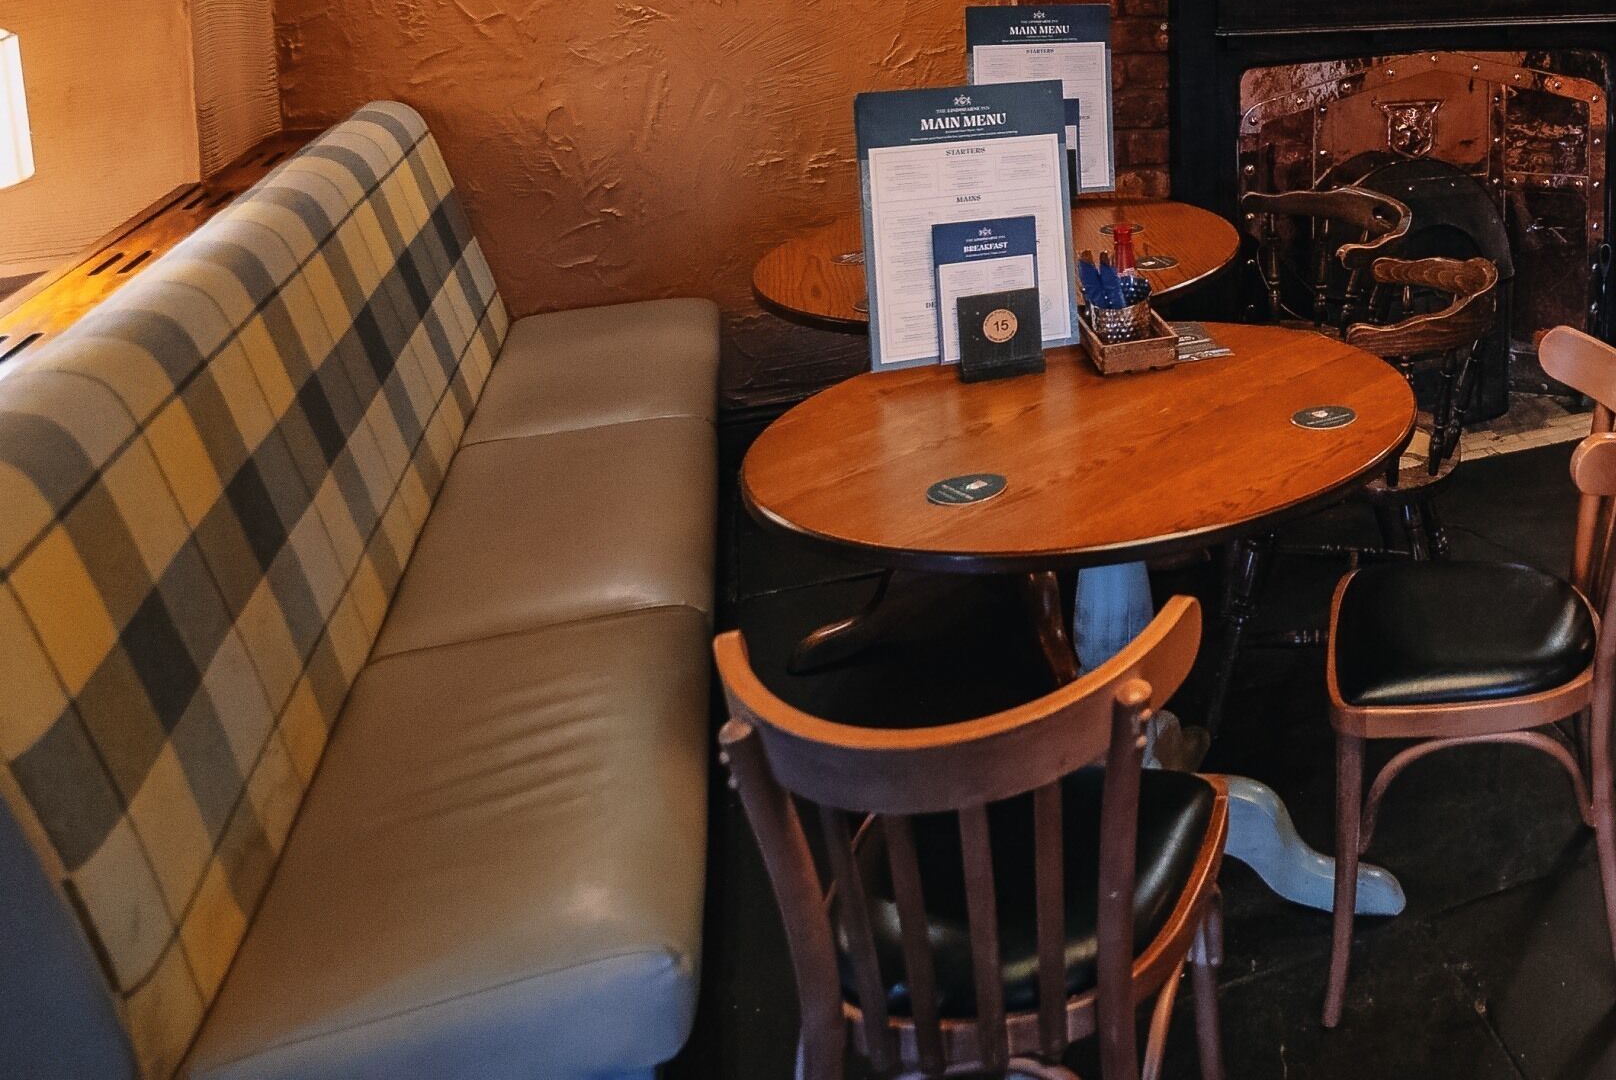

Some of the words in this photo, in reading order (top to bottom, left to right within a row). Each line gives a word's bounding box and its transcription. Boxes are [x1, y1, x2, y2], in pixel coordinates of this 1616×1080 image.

[1009, 25, 1038, 35] MAIN
[1039, 25, 1070, 35] MENU
[920, 116, 960, 131] MAIN
[963, 112, 1007, 128] MENU
[945, 147, 985, 156] STARTERS
[956, 195, 981, 203] MAINS
[963, 241, 1008, 253] BREAKFAST
[993, 319, 1009, 332] 15
